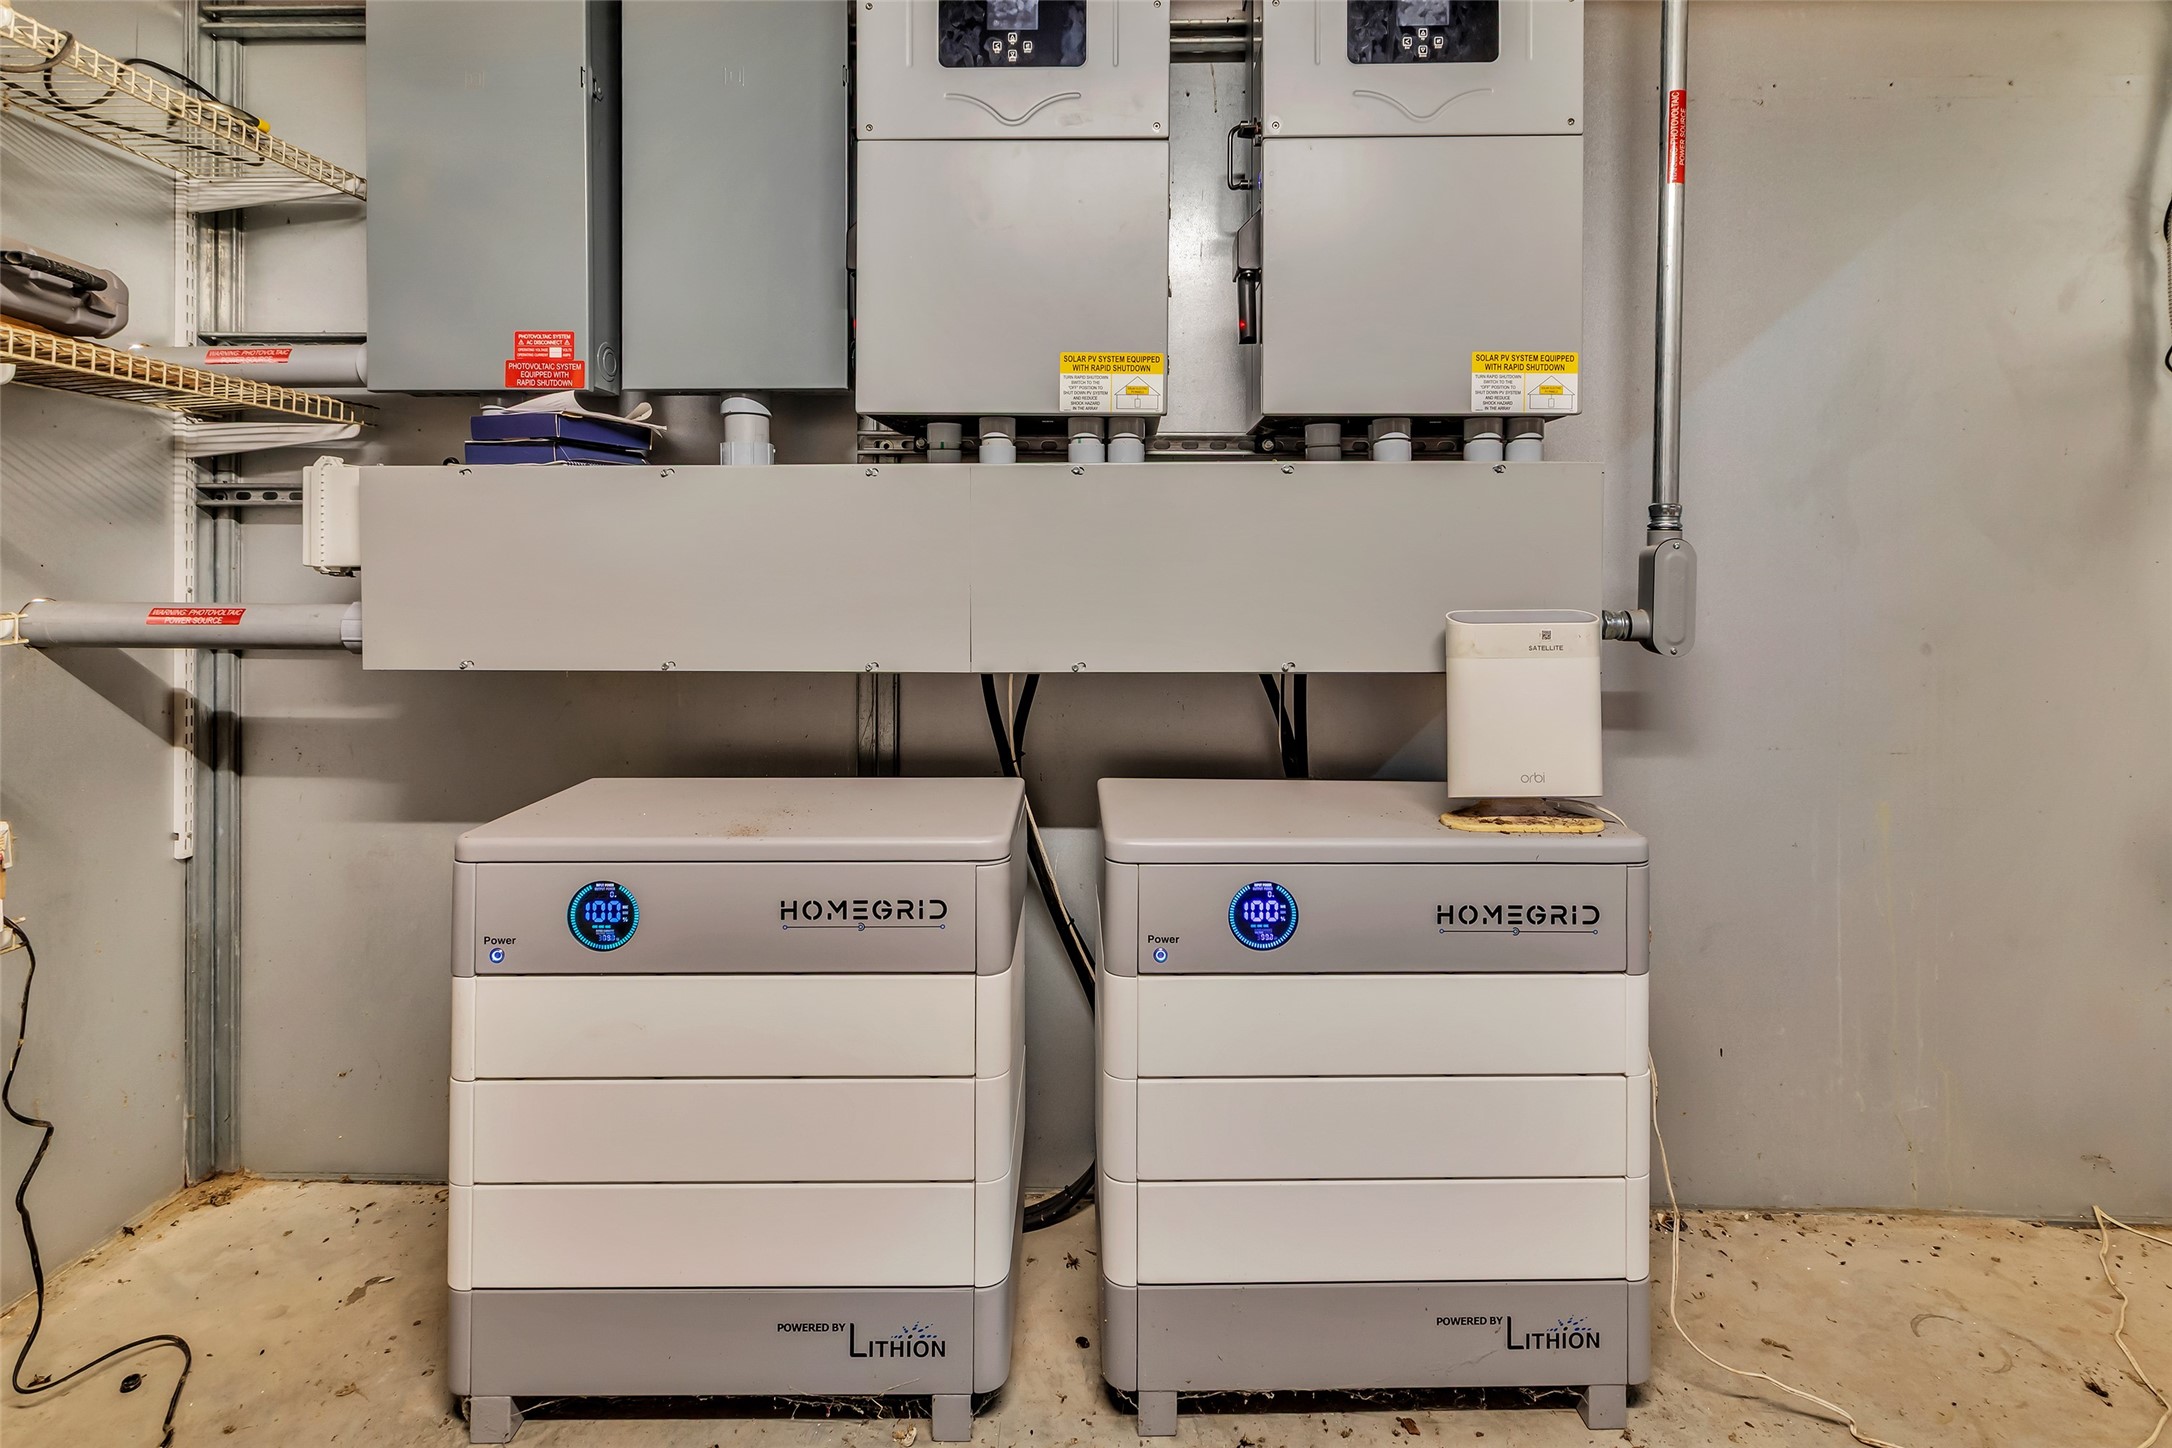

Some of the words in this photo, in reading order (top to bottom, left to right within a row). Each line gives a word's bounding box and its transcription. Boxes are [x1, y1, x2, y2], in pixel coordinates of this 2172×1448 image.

[1521, 772, 1545, 783] orbi
[585, 901, 621, 922] 100
[781, 900, 947, 920] HOMEGRID
[1244, 900, 1278, 922] 100
[1437, 905, 1600, 924] HOMEGRID
[1148, 935, 1179, 943] Power
[777, 1324, 829, 1332] POWERED
[832, 1324, 846, 1332] BY
[1437, 1317, 1487, 1326] POWERED
[1490, 1317, 1503, 1326] BY
